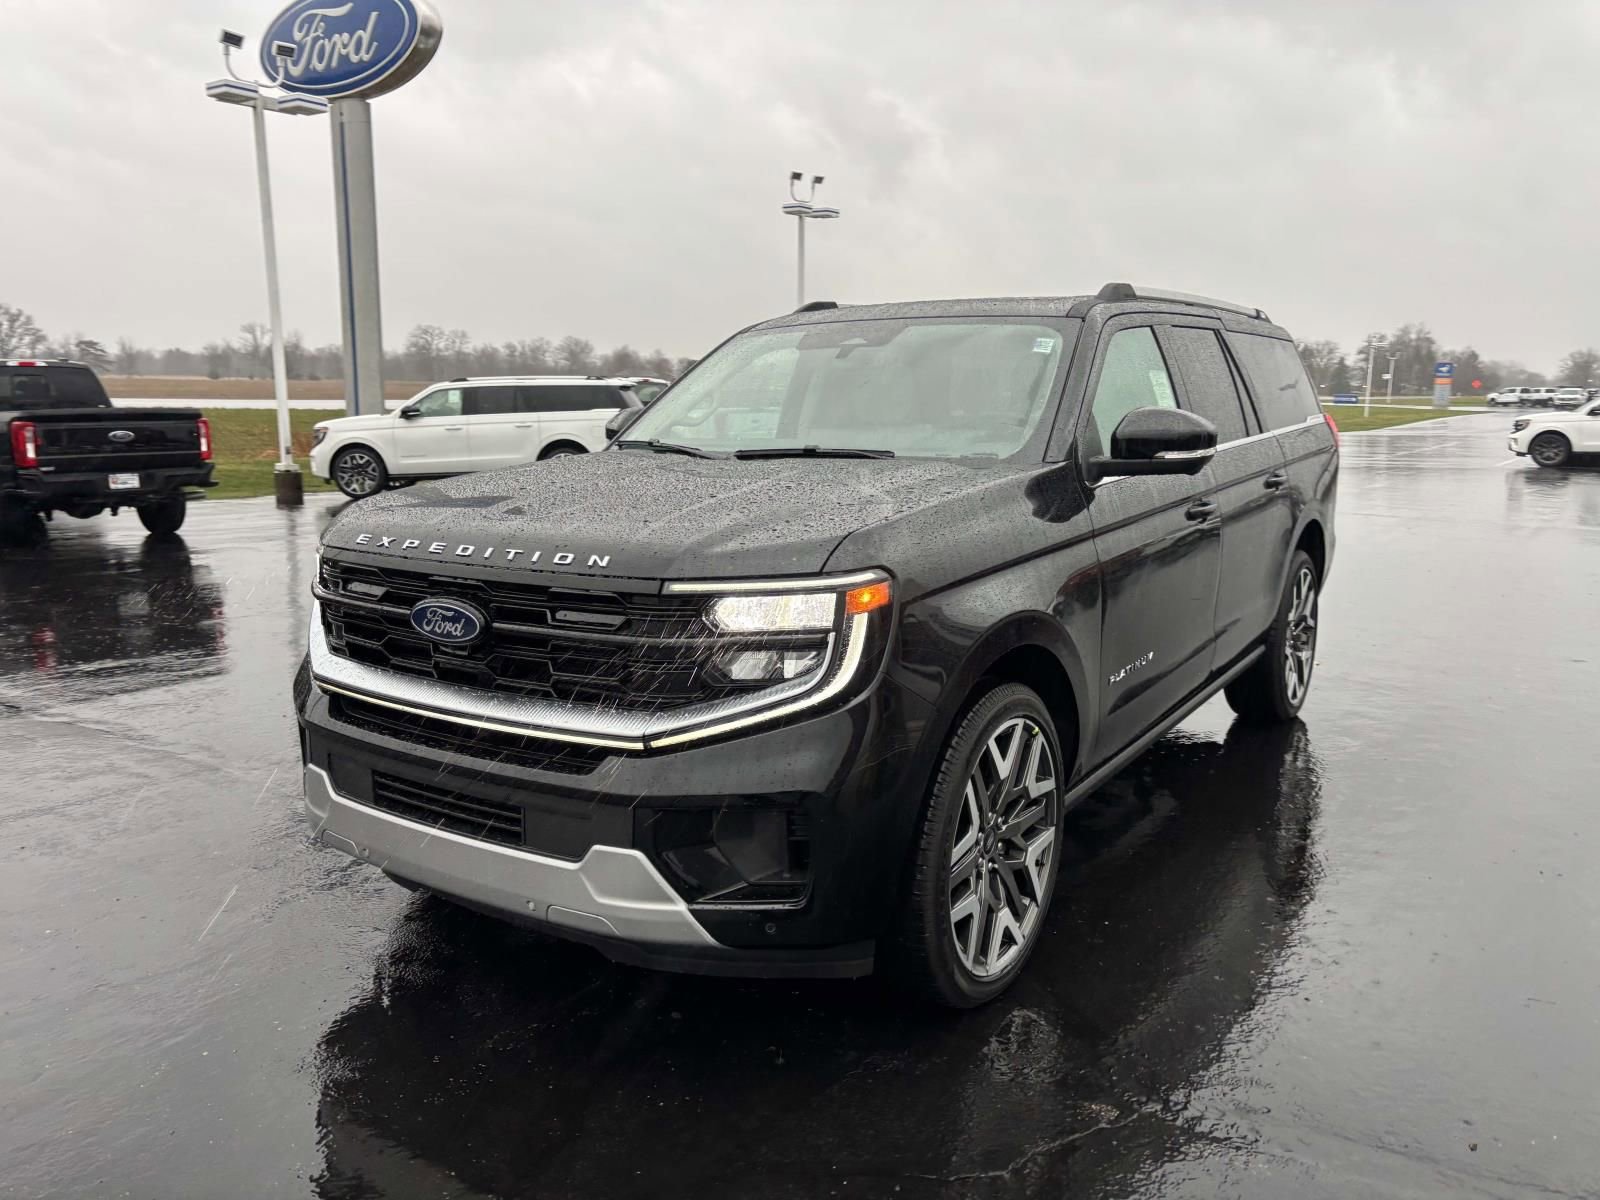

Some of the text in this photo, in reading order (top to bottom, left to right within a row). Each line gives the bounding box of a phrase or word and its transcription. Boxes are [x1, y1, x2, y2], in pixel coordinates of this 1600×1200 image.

[287, 5, 380, 77] Ford
[355, 533, 611, 568] EXPEDITION
[423, 607, 466, 637] Ford
